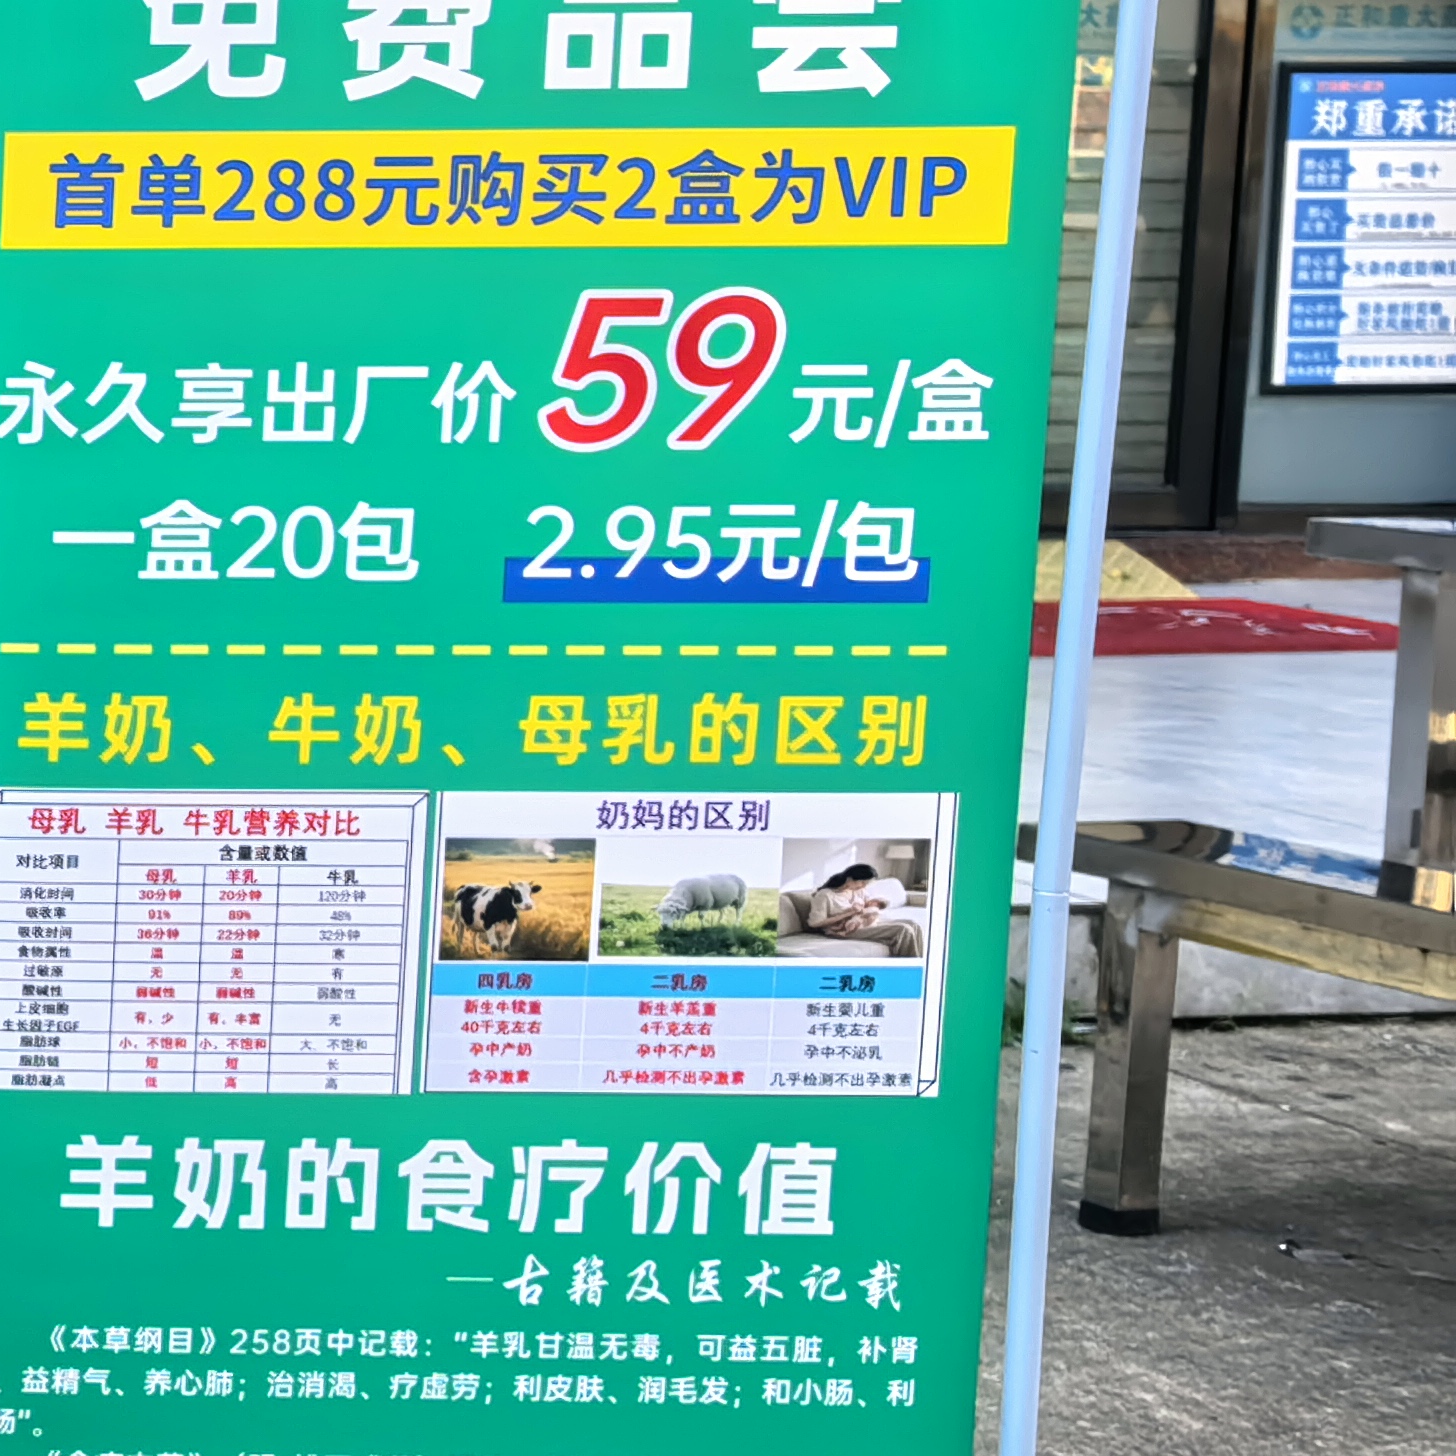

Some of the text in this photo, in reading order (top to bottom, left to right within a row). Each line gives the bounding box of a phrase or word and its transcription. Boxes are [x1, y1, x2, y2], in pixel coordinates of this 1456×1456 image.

[48, 152, 969, 229] 首单288元购买2盒为VIP
[52, 499, 920, 588] 一盒20包 2.95元/包
[16, 692, 929, 769] 羊奶、牛奶、母乳的区别
[28, 808, 361, 837] 母乳 羊乳 牛乳营养对比
[595, 799, 771, 831] 奶妈的区别
[15, 853, 80, 869] 对比项目
[218, 845, 308, 862] 含量或数值
[478, 973, 876, 993] 四乳房 二乳房 二乳房
[806, 1002, 885, 1019] 新生婴儿重
[461, 1020, 880, 1038] 40千克左右 4千克左右 4千克左右
[469, 1042, 716, 1059] 孕中产奶 孕中不产奶
[467, 1069, 913, 1088] 含孕激素 几乎检测不出孕激素 几乎检测不出孕激素
[60, 1135, 837, 1236] 羊奶的食疗价值
